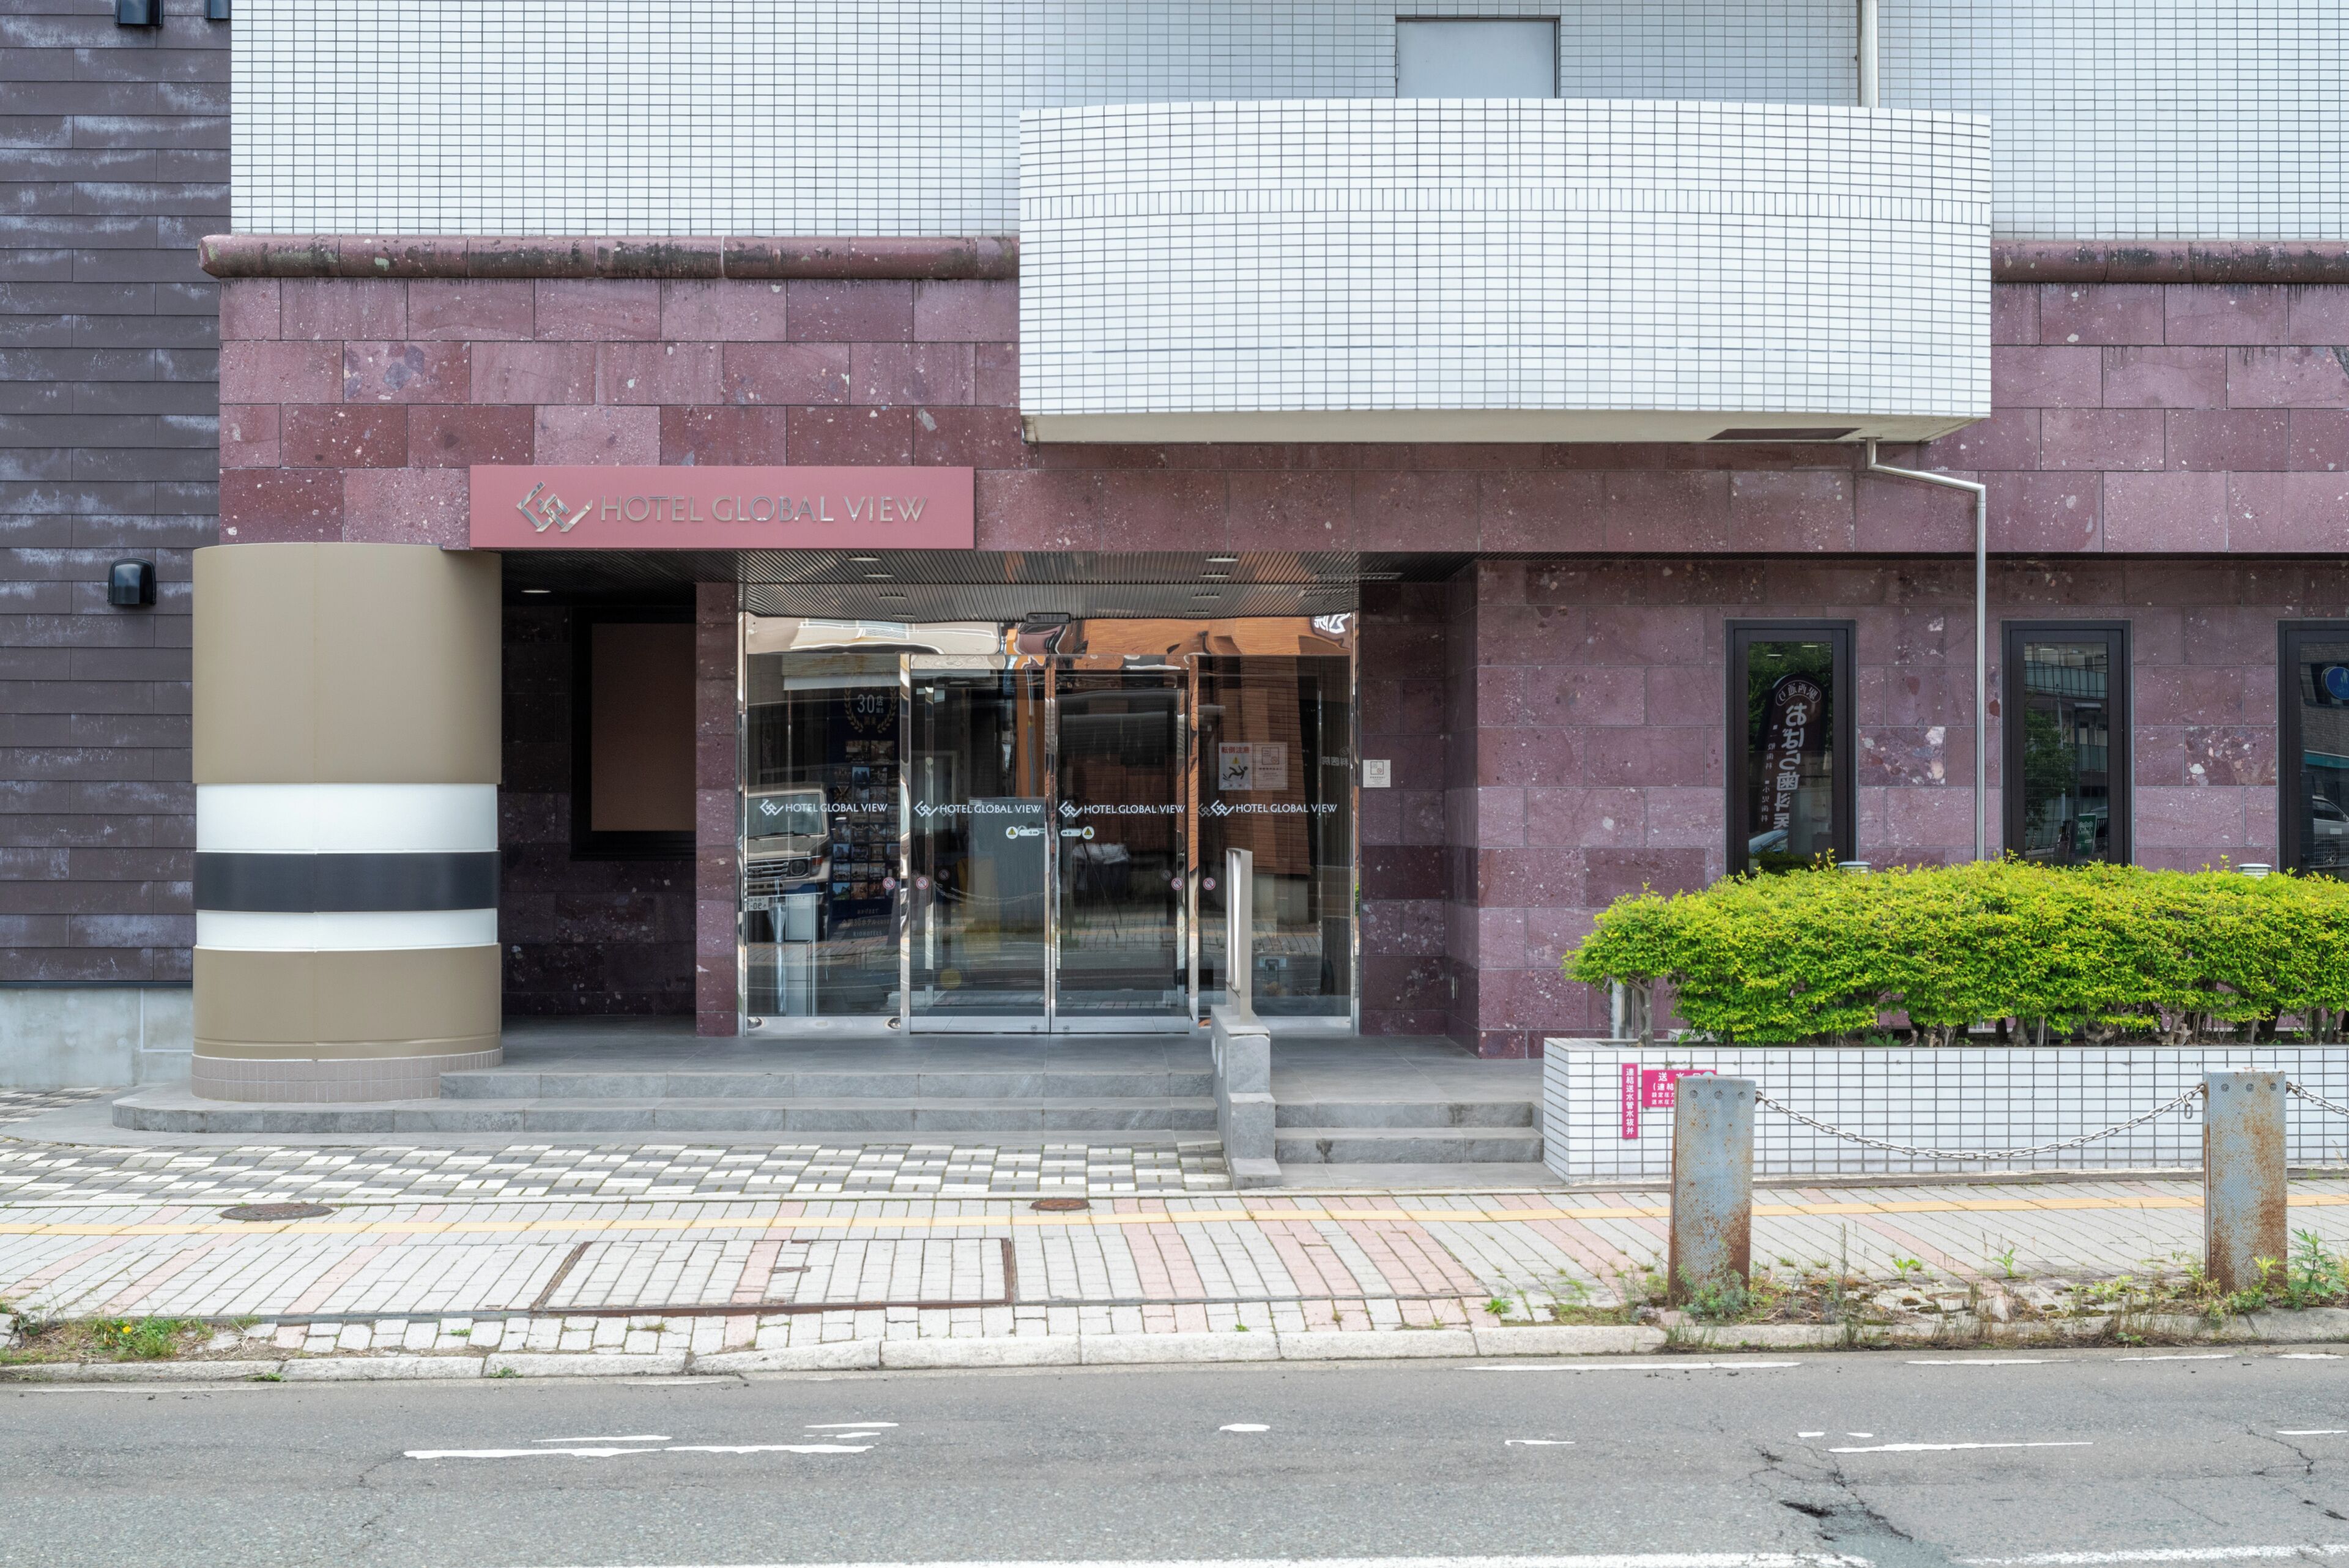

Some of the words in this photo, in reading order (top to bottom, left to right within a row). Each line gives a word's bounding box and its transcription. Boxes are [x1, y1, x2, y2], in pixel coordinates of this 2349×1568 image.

[600, 495, 704, 522] HOTEL
[711, 495, 834, 522] GLOBAL
[843, 495, 928, 522] VIEW
[785, 803, 818, 812] HOTEL
[820, 803, 859, 812] GLOBAL
[861, 803, 888, 812] VIEW
[940, 804, 973, 814] HOTEL
[974, 804, 1012, 814] GLOBAL
[1014, 804, 1041, 814] VIEW
[1084, 804, 1118, 814] HOTEL
[1118, 804, 1157, 814] GLOBAL
[1159, 804, 1186, 814] VIEW
[1236, 803, 1269, 813] HOTEL
[1270, 803, 1308, 813] GLOBAL
[1310, 803, 1337, 813] VIEW
